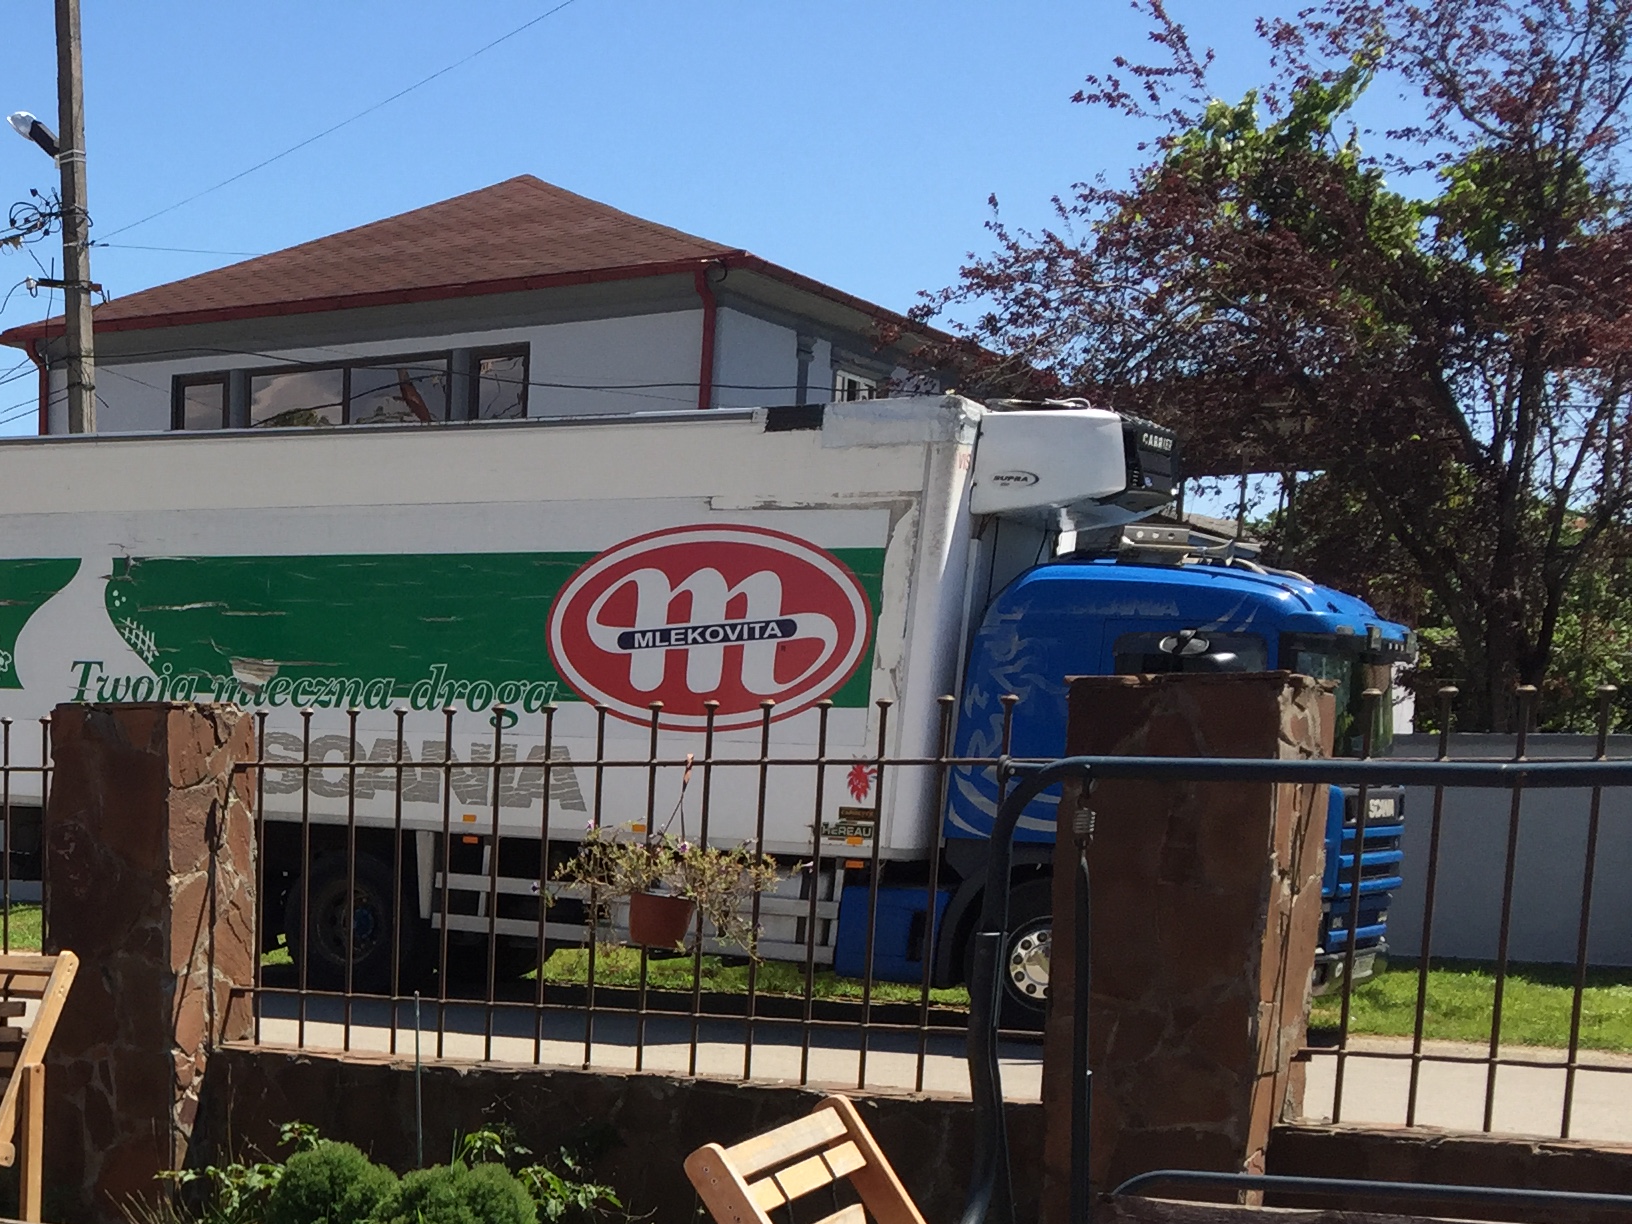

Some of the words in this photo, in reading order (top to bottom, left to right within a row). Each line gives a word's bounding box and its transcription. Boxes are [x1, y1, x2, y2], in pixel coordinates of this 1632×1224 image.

[634, 621, 783, 648] MLEKOVITA
[70, 660, 197, 702] Twoja
[409, 663, 558, 729] droga
[262, 731, 587, 811] SCANIA
